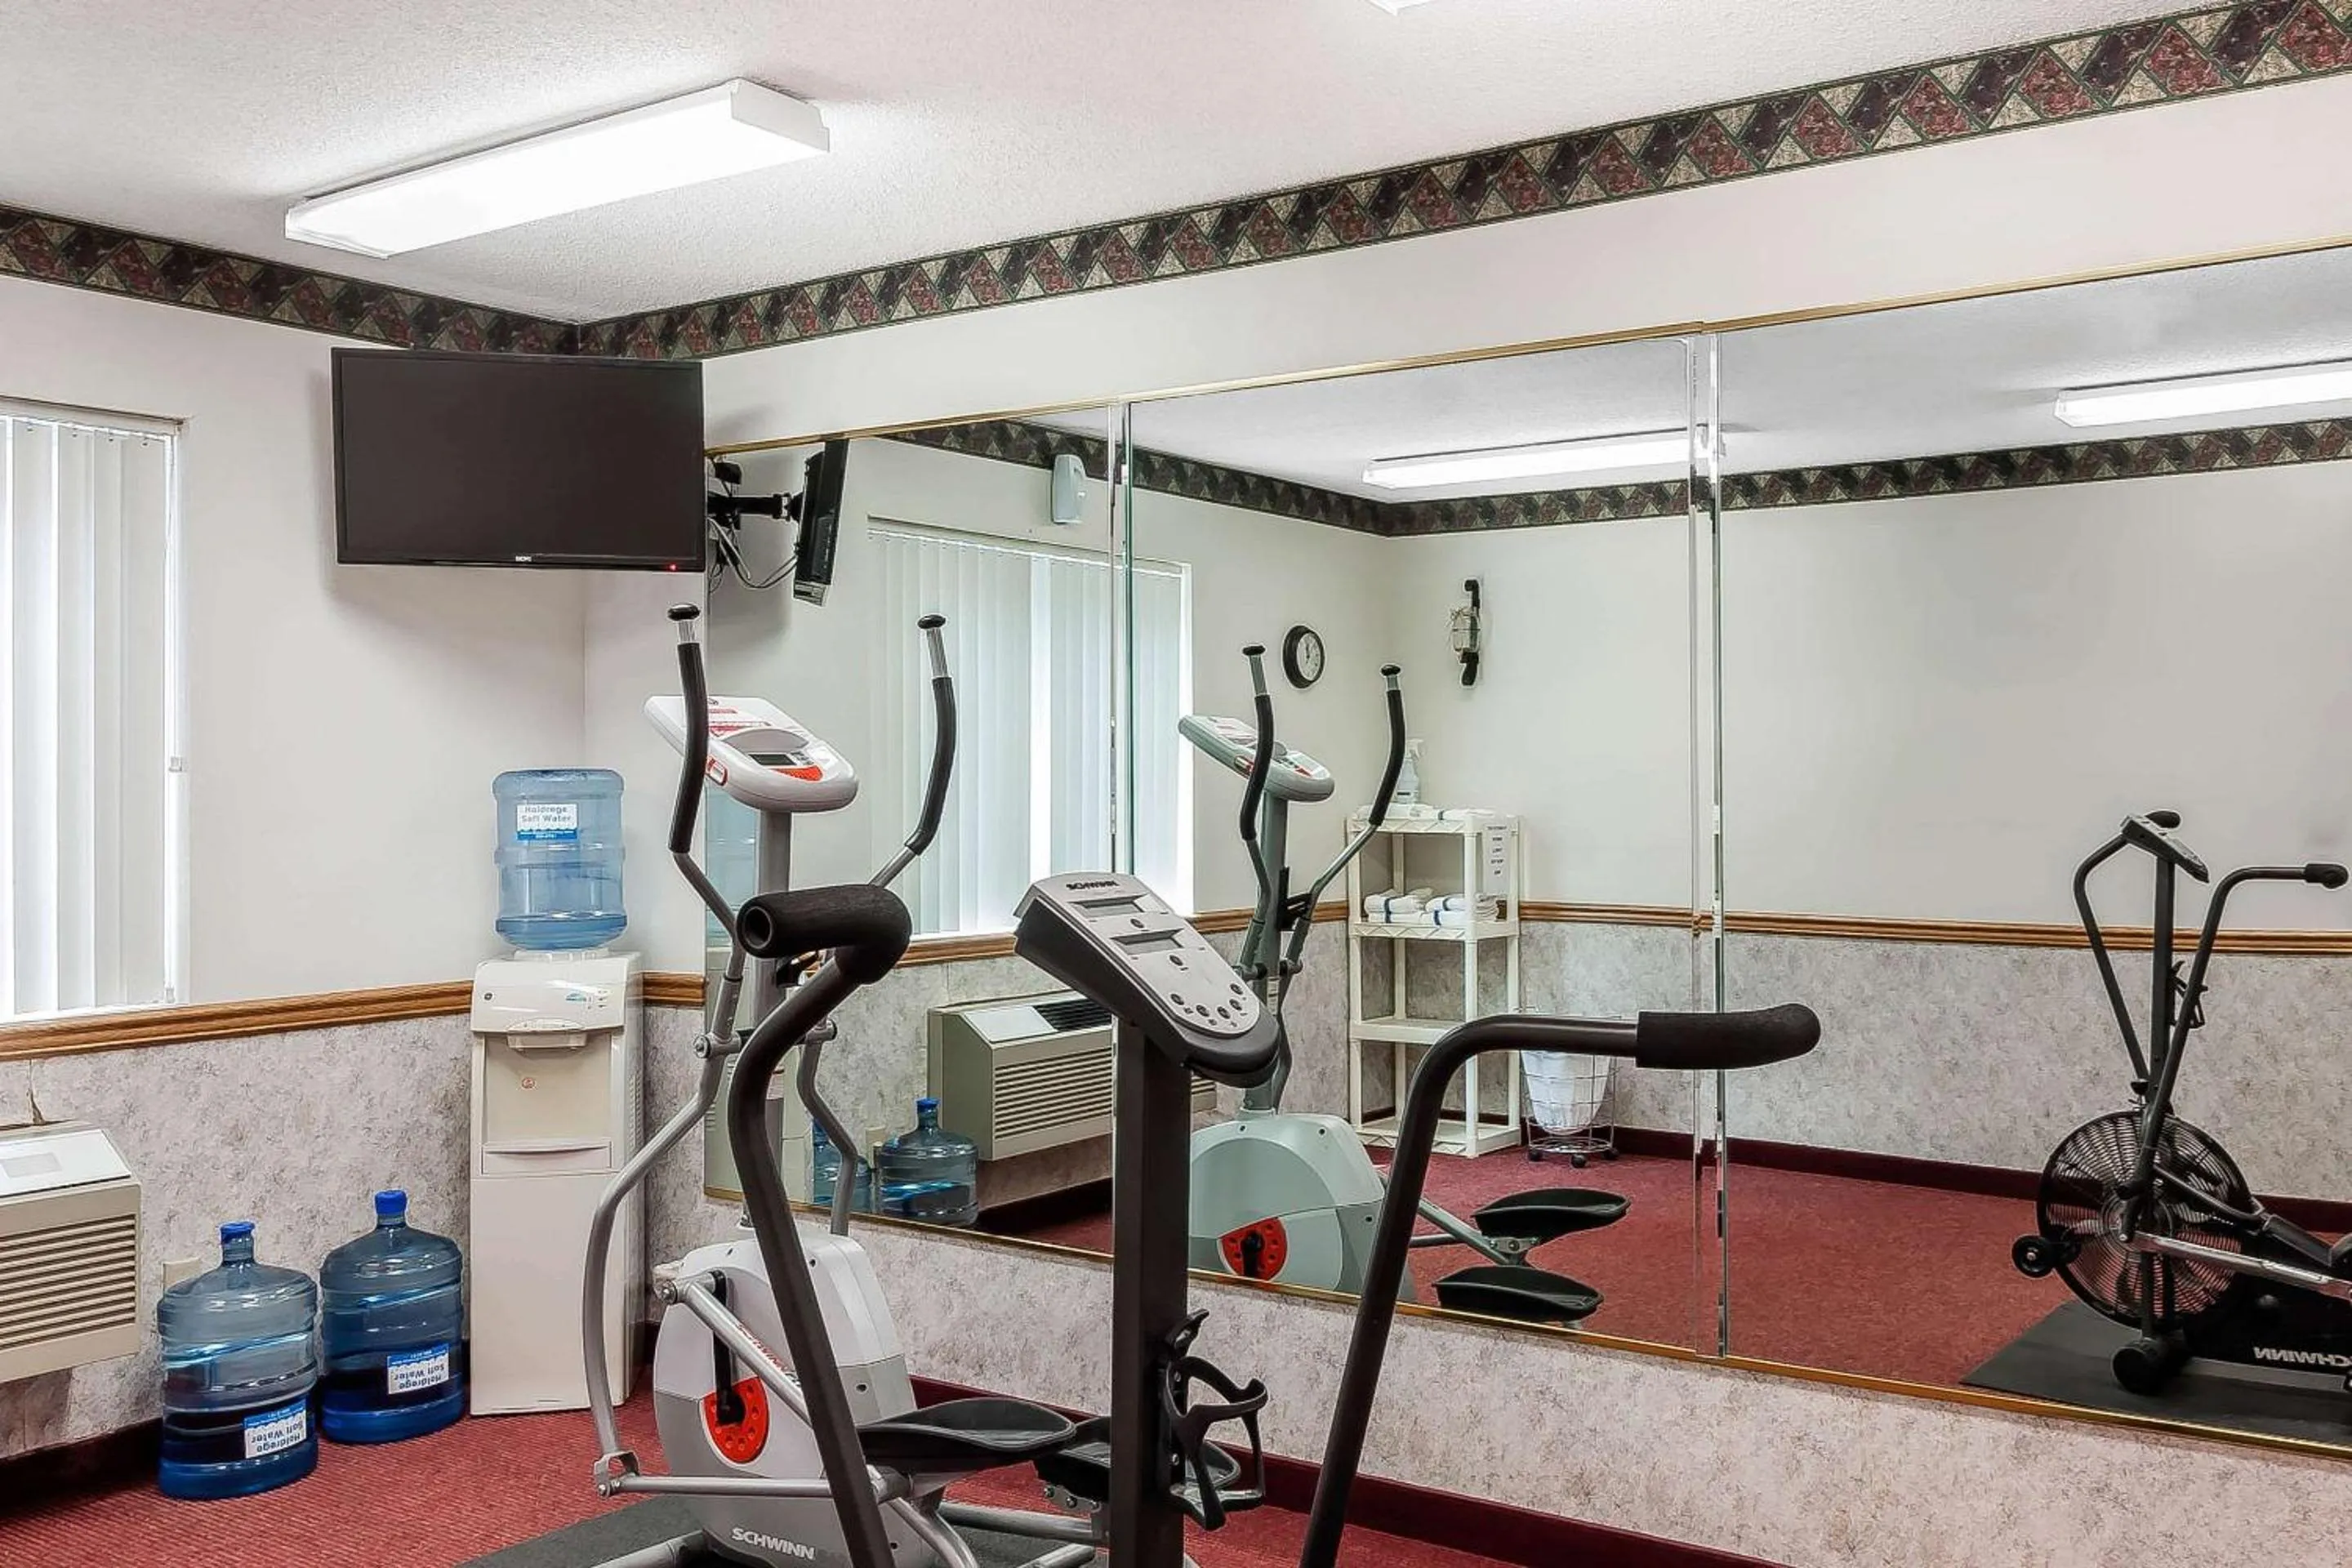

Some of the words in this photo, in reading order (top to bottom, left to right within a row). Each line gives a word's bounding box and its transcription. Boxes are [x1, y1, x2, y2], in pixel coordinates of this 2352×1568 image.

[541, 814, 571, 822] Water
[394, 1368, 425, 1380] Water
[251, 1428, 283, 1443] Water
[731, 1526, 816, 1561] SCHWINN
